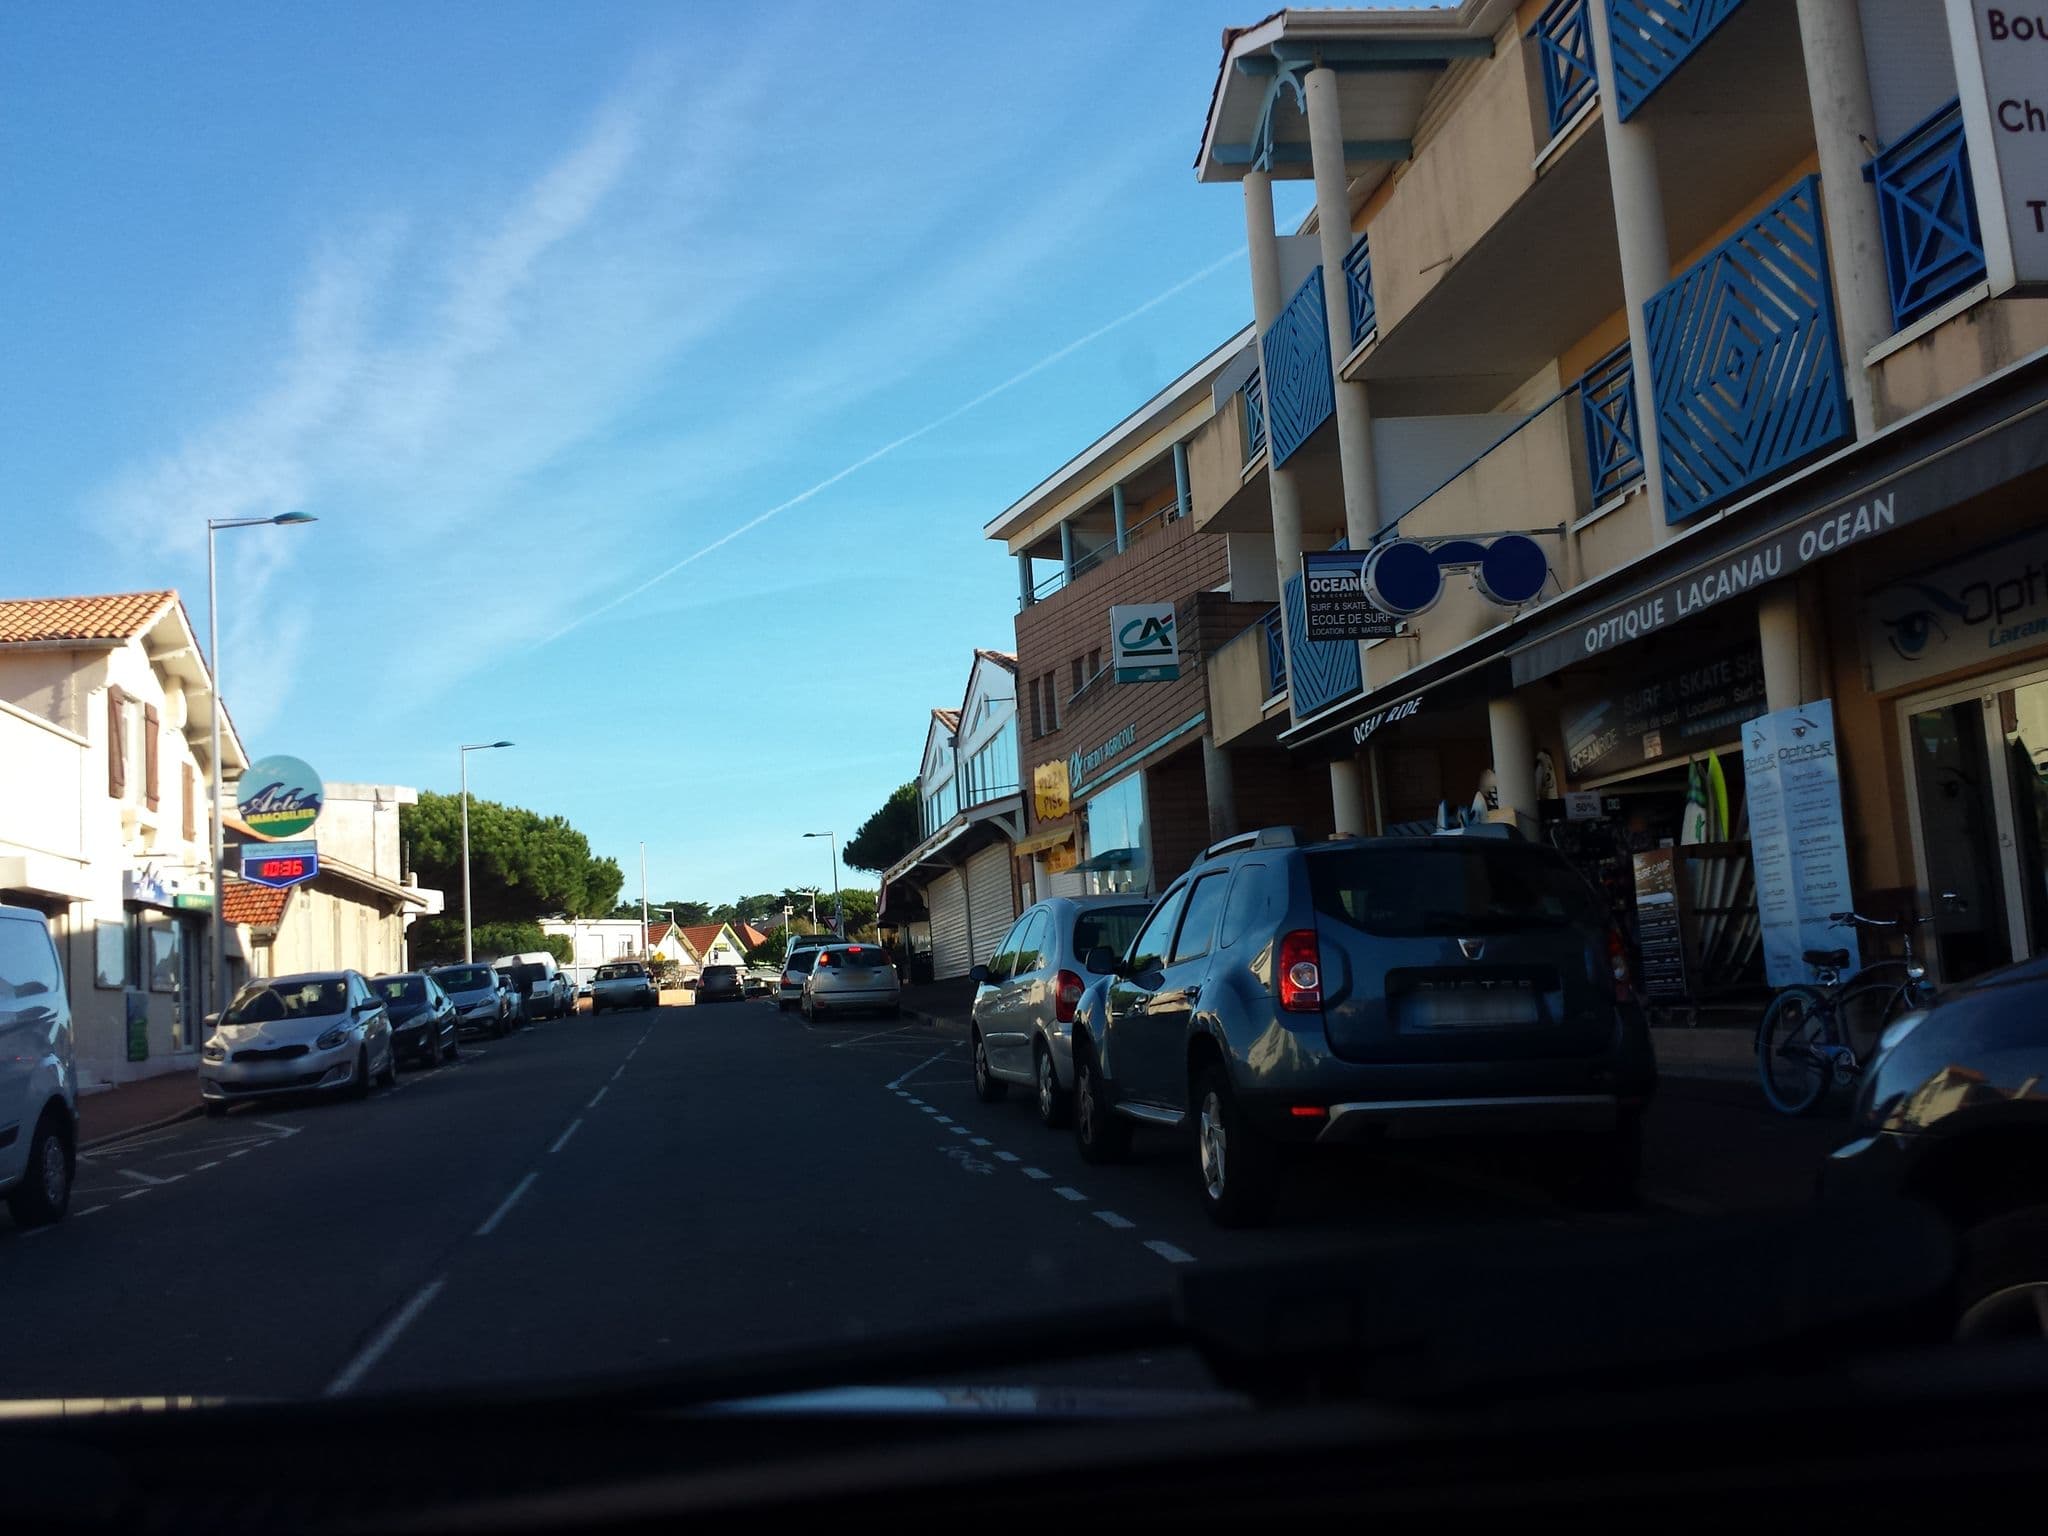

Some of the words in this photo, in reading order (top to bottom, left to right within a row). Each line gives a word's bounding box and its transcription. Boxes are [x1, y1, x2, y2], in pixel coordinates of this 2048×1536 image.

[1998, 99, 2048, 132] Ch
[1584, 597, 1665, 653] OPTIQUE
[1676, 544, 1782, 615] LACANAU
[1799, 492, 1895, 561] OCEAN
[1309, 577, 1363, 593] OCEAN
[1311, 602, 1331, 612] SURF
[1342, 601, 1367, 611] SKATE
[1311, 614, 1346, 626] ECOLE
[1347, 613, 1363, 625] DE
[1364, 611, 1392, 623] SURF
[1311, 626, 1345, 636] LOCATION
[1348, 626, 1359, 634] DE
[1384, 696, 1424, 724] RIDE
[262, 860, 303, 877] 10:36
